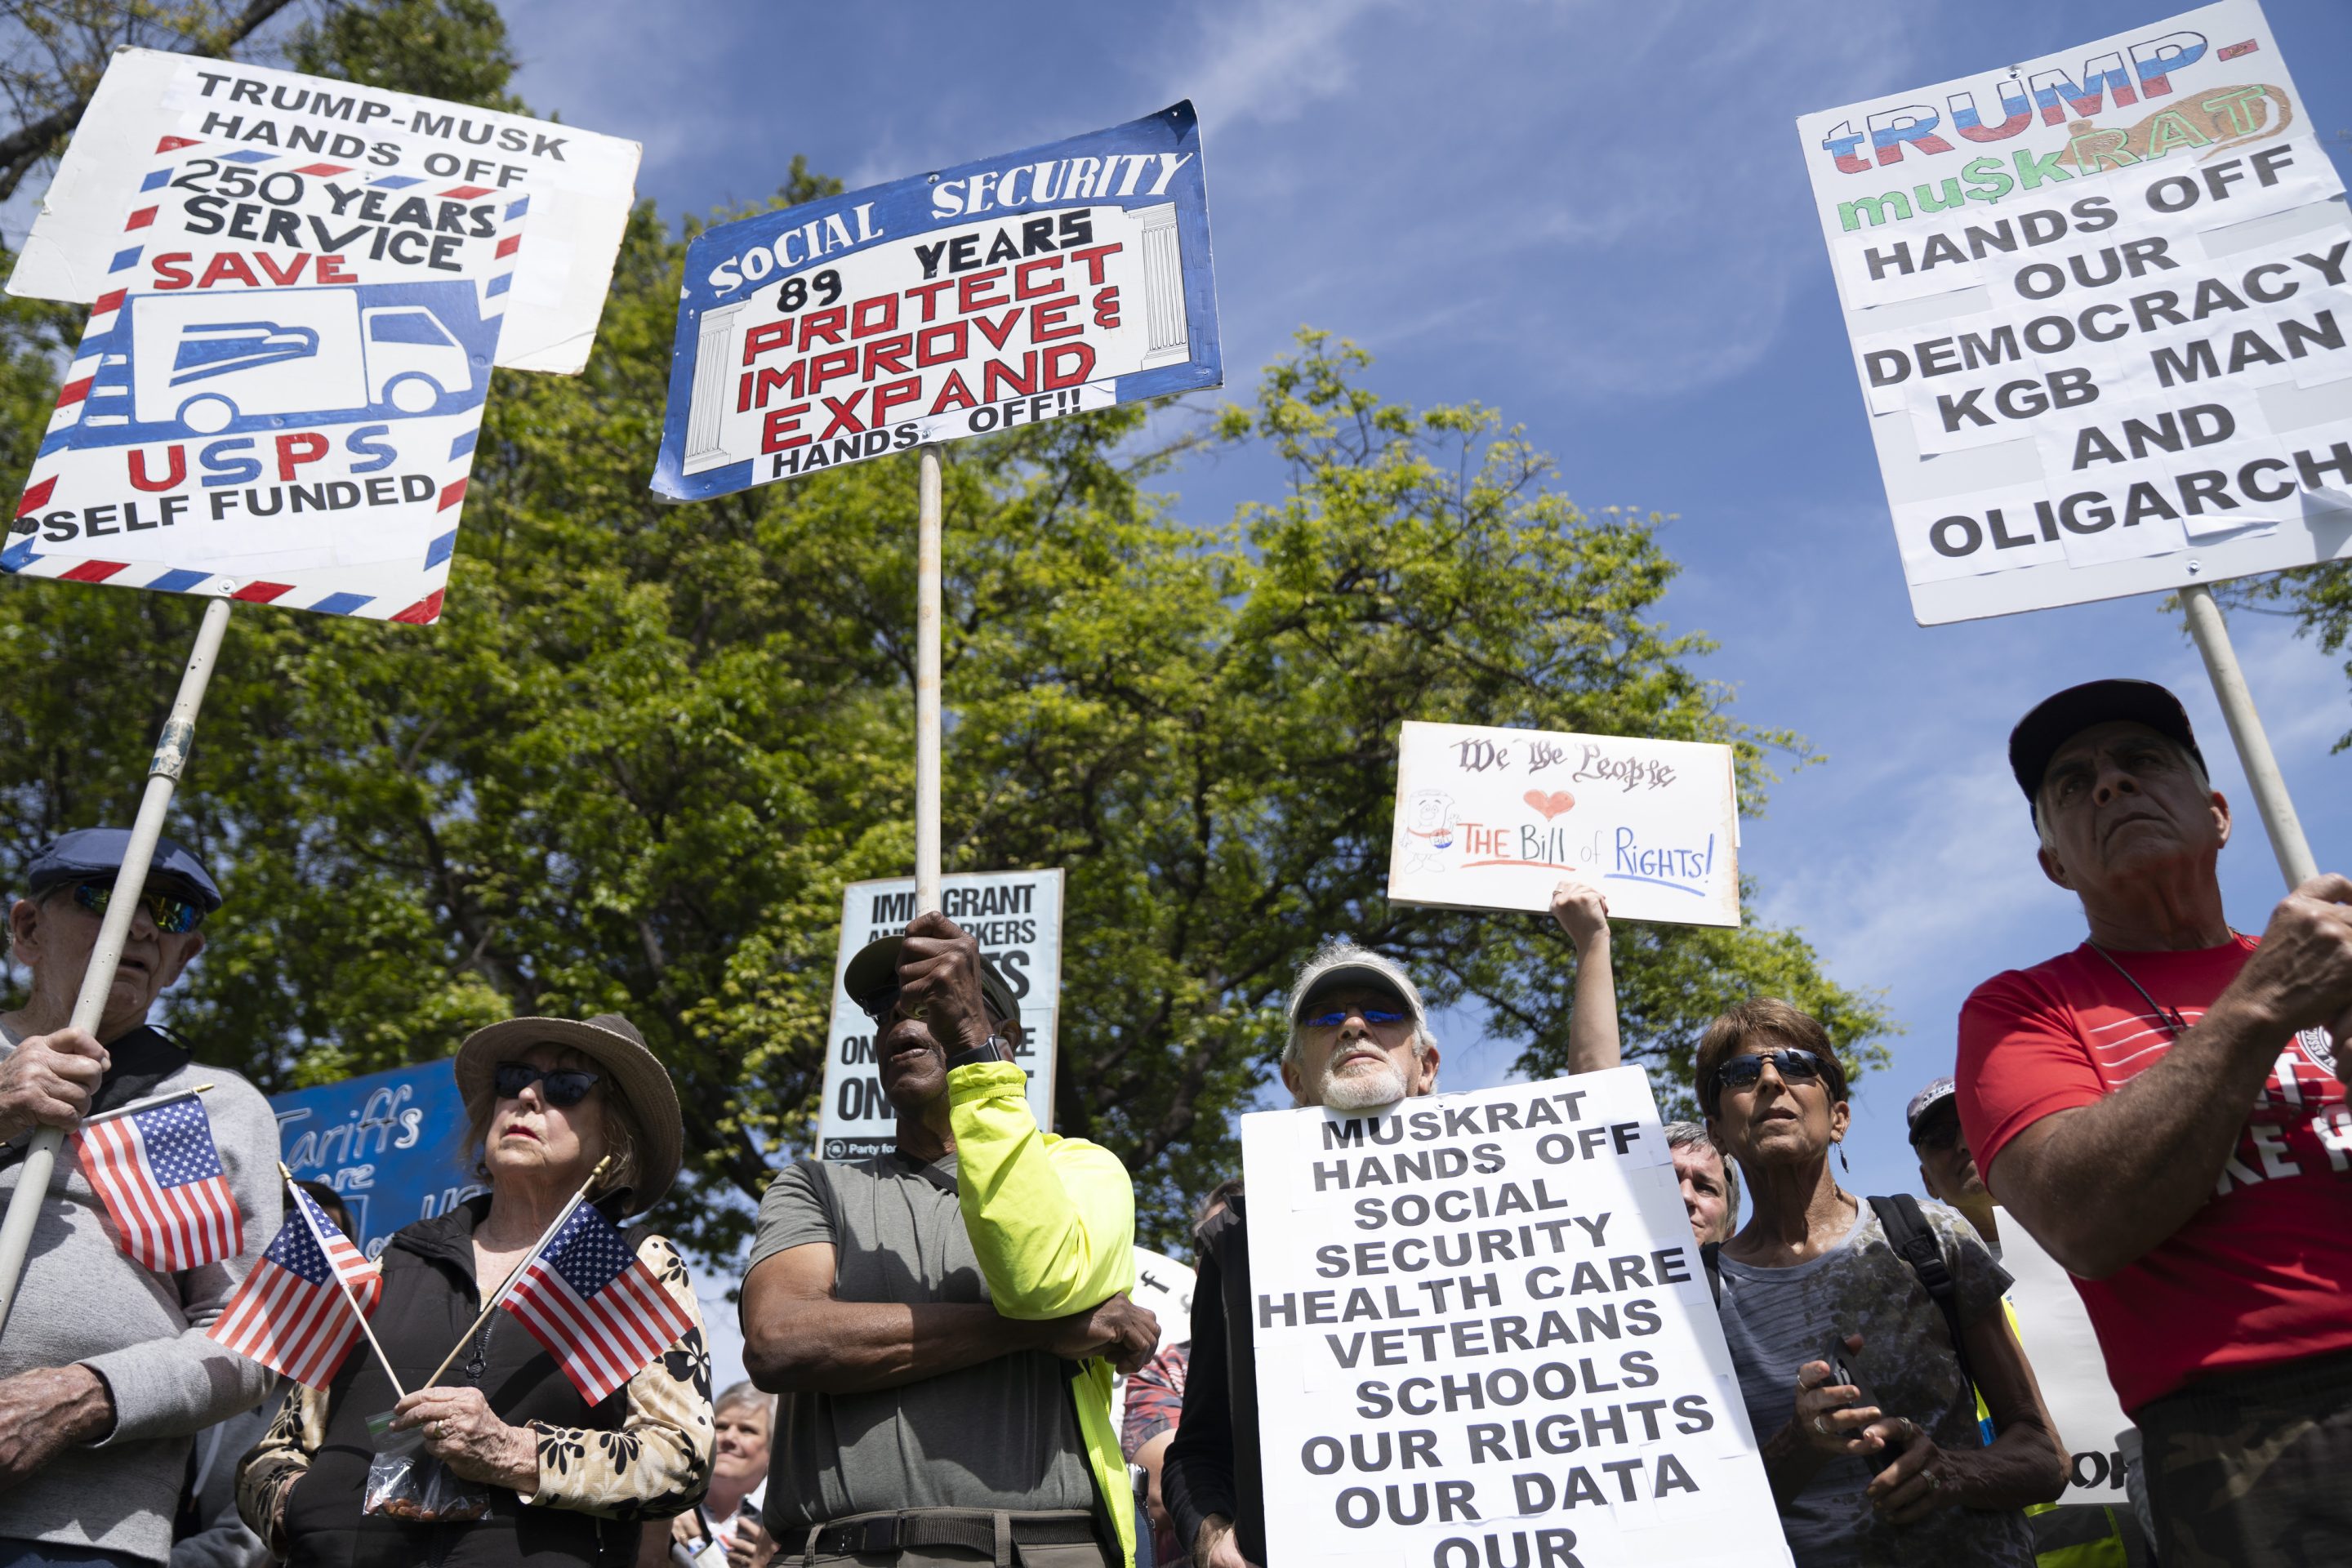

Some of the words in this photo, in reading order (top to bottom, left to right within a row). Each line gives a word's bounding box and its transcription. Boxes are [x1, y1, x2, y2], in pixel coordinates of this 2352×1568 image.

[197, 73, 568, 162] TRUMP-MUSK
[200, 112, 400, 167] HANDS
[425, 153, 528, 189] OFF
[171, 159, 304, 206] 250
[324, 184, 497, 238] YEARS
[185, 196, 464, 272] SERVICE
[709, 202, 884, 297] SOCIAL
[932, 152, 1193, 220] SECURITY
[1863, 195, 2118, 281] HANDS
[2145, 144, 2294, 213] OFF
[152, 252, 359, 289] SAVE
[777, 269, 841, 312] 89
[915, 208, 1094, 279] YEARS
[2014, 236, 2180, 300] OUR
[742, 243, 1123, 366] PROTECT
[1864, 239, 2352, 387] DEMOCRACY
[737, 295, 1084, 412] IMPROVE
[1937, 366, 2100, 433] KGB
[2149, 308, 2346, 387] MAN
[761, 341, 1096, 454] EXPAND
[773, 422, 920, 478] HANDS
[969, 387, 1081, 434] OFF!!
[127, 425, 398, 492] USPS
[2072, 403, 2235, 470] AND
[43, 497, 189, 542] SELF
[211, 474, 436, 520] FUNDED
[1929, 442, 2352, 558] OLIGARCH
[1450, 737, 1511, 772] We
[1456, 822, 1511, 858] THE
[1580, 830, 1602, 864] of
[871, 884, 1036, 924] IMGRANT
[960, 919, 1036, 946] KERS
[841, 1035, 877, 1065] ON
[274, 1084, 423, 1174] Tariffs
[838, 1077, 898, 1121] ON
[1322, 1090, 1587, 1150] MUSKRAT
[849, 1143, 880, 1156] Party
[881, 1143, 898, 1154] for
[1312, 1143, 1505, 1192] HANDS
[1537, 1121, 1642, 1165] OFF
[1353, 1178, 1568, 1231] SOCIAL
[1315, 1212, 1612, 1279] SECURITY
[1258, 1273, 1503, 1329] HEALTH
[1525, 1247, 1691, 1301] CARE
[1324, 1298, 1663, 1369] VETERANS
[1356, 1350, 1659, 1420] SCHOOLS
[1301, 1428, 1442, 1475] OUR
[1467, 1395, 1714, 1464] RIGHTS
[1335, 1480, 1481, 1528] OUR
[1512, 1454, 1699, 1516] DATA
[1433, 1528, 1584, 1568] OUR
